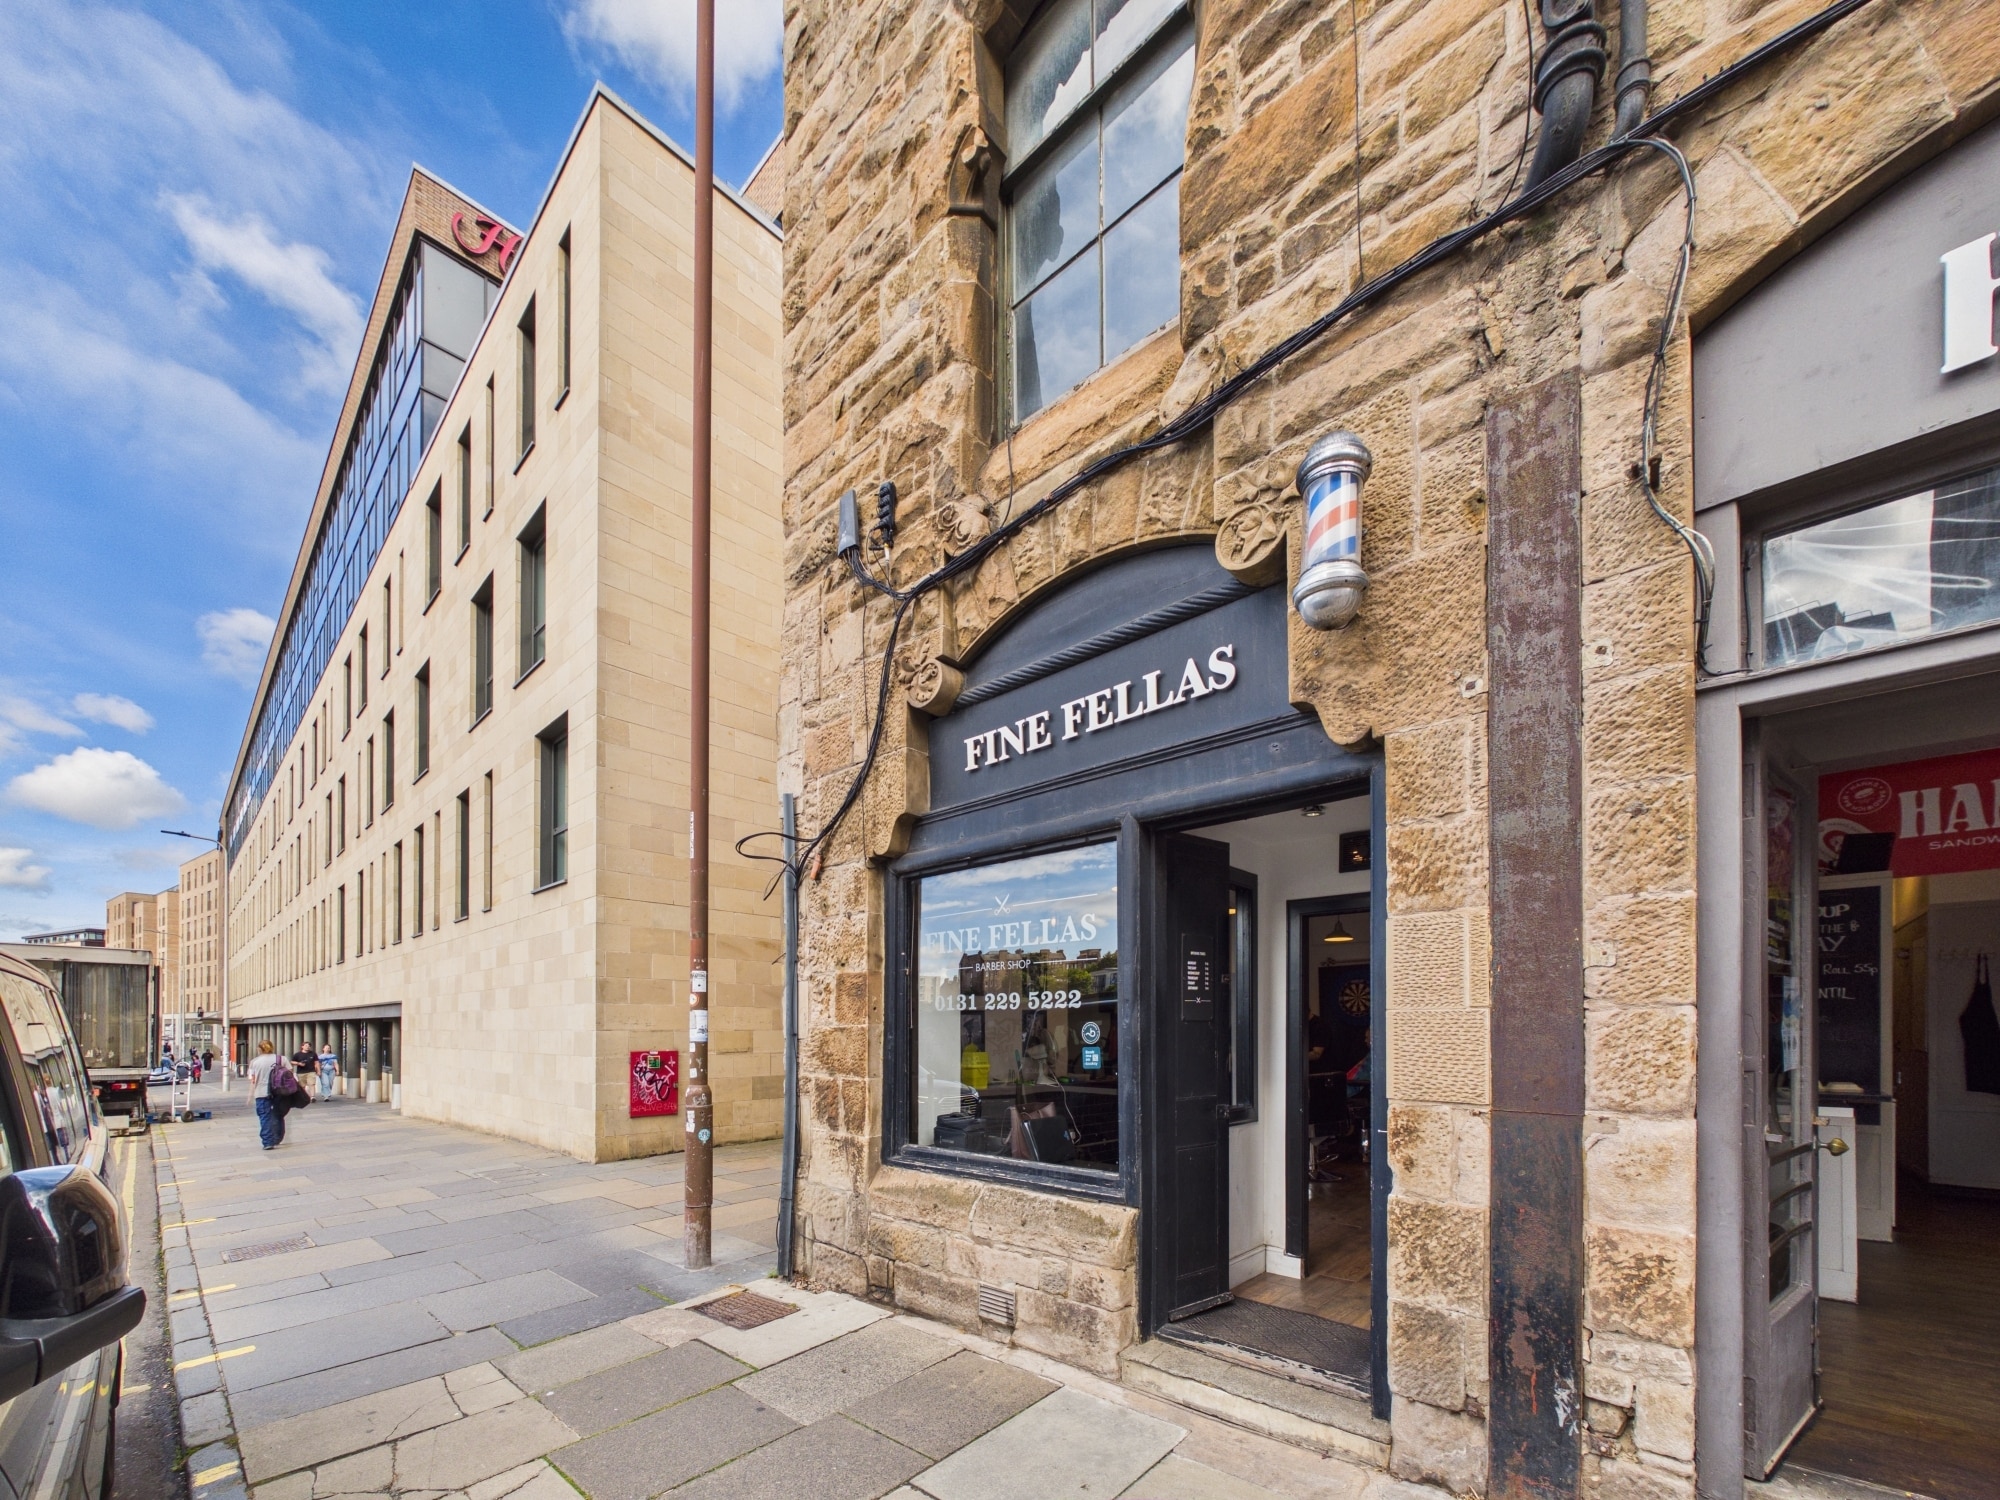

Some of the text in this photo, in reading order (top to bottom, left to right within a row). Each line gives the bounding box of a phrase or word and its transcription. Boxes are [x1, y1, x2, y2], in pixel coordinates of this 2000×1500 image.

[964, 644, 1237, 772] FINE FELLAS
[924, 912, 1097, 953] FINE FELLAS
[975, 959, 1031, 972] BARBER SHOP
[934, 989, 1082, 1012] 0131 229 5222
